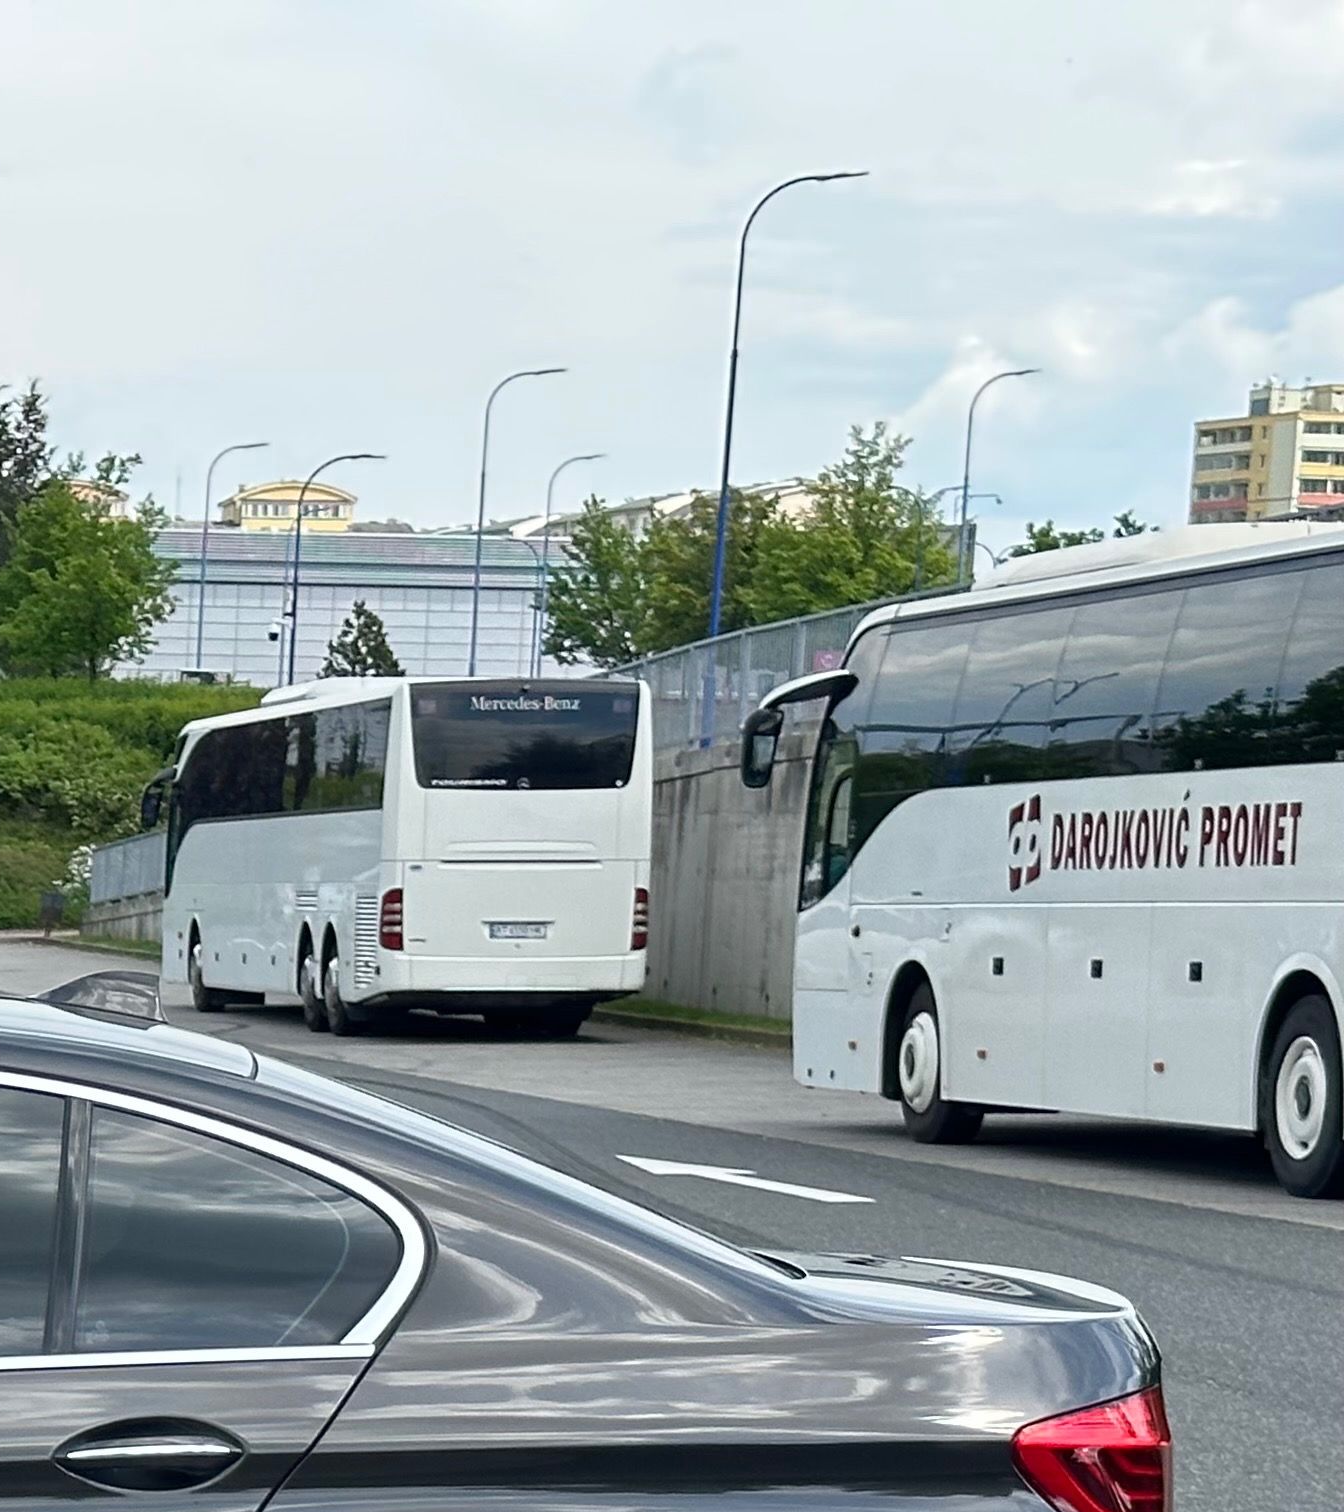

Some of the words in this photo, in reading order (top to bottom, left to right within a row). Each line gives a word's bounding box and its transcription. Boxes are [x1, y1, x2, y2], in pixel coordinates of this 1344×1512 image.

[470, 696, 581, 711] Mercedes-Benz
[1050, 789, 1190, 870] DAROJKOVIĆ
[1199, 801, 1302, 868] PROMET
